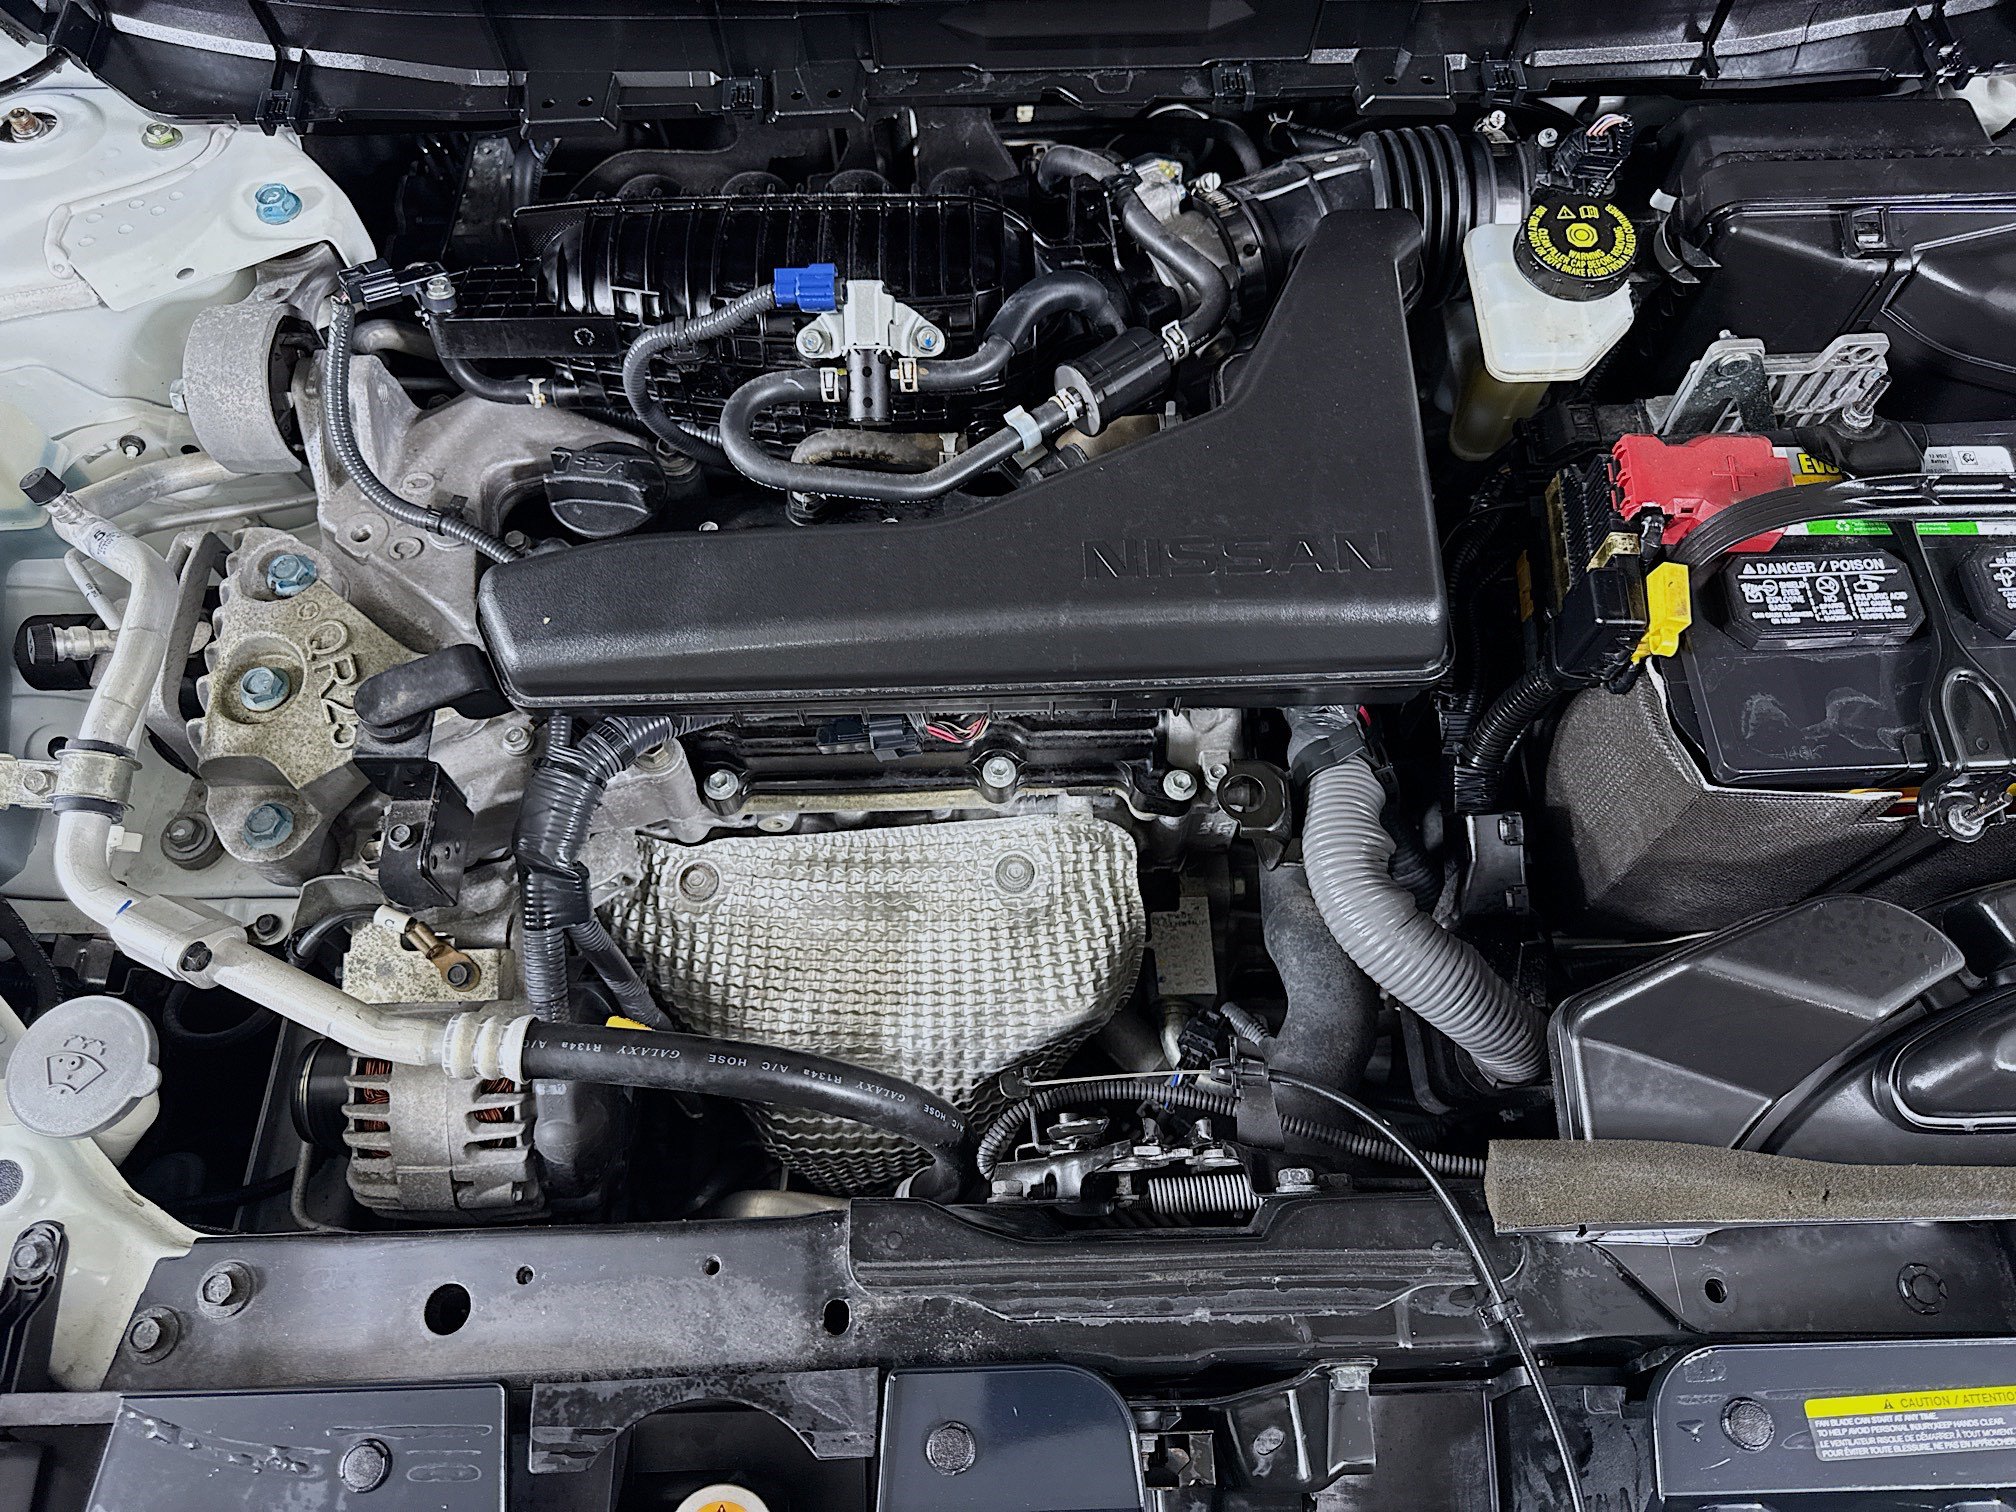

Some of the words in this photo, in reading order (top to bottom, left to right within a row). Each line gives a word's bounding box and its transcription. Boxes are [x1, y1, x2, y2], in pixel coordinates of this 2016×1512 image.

[1605, 203, 1634, 234] CONTAINER
[1535, 246, 1547, 256] OR
[1538, 228, 1552, 251] CLEAN
[1547, 247, 1570, 264] FILLER
[1571, 259, 1586, 267] CAP
[1587, 254, 1616, 268] BEFORE
[1611, 226, 1625, 257] REMOVING
[1624, 234, 1636, 257] SEALED
[1543, 254, 1562, 269] DOT4
[1569, 249, 1605, 260] WARNING
[1561, 264, 1586, 277] BRAKE
[1587, 266, 1608, 277] FLUID
[1606, 259, 1627, 273] FROM
[1082, 531, 1392, 579] NISSAN
[1756, 562, 1816, 575] DANGER
[1830, 558, 1885, 571] POISON
[1766, 595, 1805, 604] EXPLOSIVE
[1823, 595, 1838, 603] NO
[561, 1041, 602, 1053] R134a
[616, 1045, 681, 1059] GALAXY
[708, 1053, 747, 1067] HOSE
[761, 1061, 789, 1073] A/C
[803, 1068, 842, 1084] R134a
[856, 1080, 906, 1103] GALAXY
[923, 1103, 947, 1121] HOSE
[1901, 1396, 1951, 1408] CAUTION
[1963, 1391, 2016, 1404] ATTENTIO
[1817, 1429, 1828, 1437] TO
[1829, 1428, 1848, 1436] HELP
[1849, 1426, 1870, 1435] AVOID
[1871, 1424, 1909, 1434] PERSONAL
[1953, 1419, 1979, 1428] HANDS
[1980, 1417, 2006, 1426] CLEAR.
[1830, 1418, 1854, 1426] BLADE
[1854, 1416, 1871, 1425] CAN
[1871, 1415, 1893, 1424] START
[1894, 1414, 1903, 1422] AT
[1904, 1413, 1919, 1421] ANY
[1830, 1437, 1876, 1447] VENTILATEUR
[1876, 1434, 1904, 1444] RISQUE
[1904, 1434, 1916, 1442] DE
[1916, 1431, 1955, 1441] DÉMARRER
[1962, 1430, 1982, 1438] TOUT
[1822, 1449, 1844, 1457] POUR
[1844, 1446, 1869, 1456] ÉVITER
[1869, 1446, 1893, 1454] TOUTE
[1933, 1442, 1945, 1450] NE
[1945, 1441, 1960, 1449] PAS
[1960, 1440, 1972, 1448] EN
